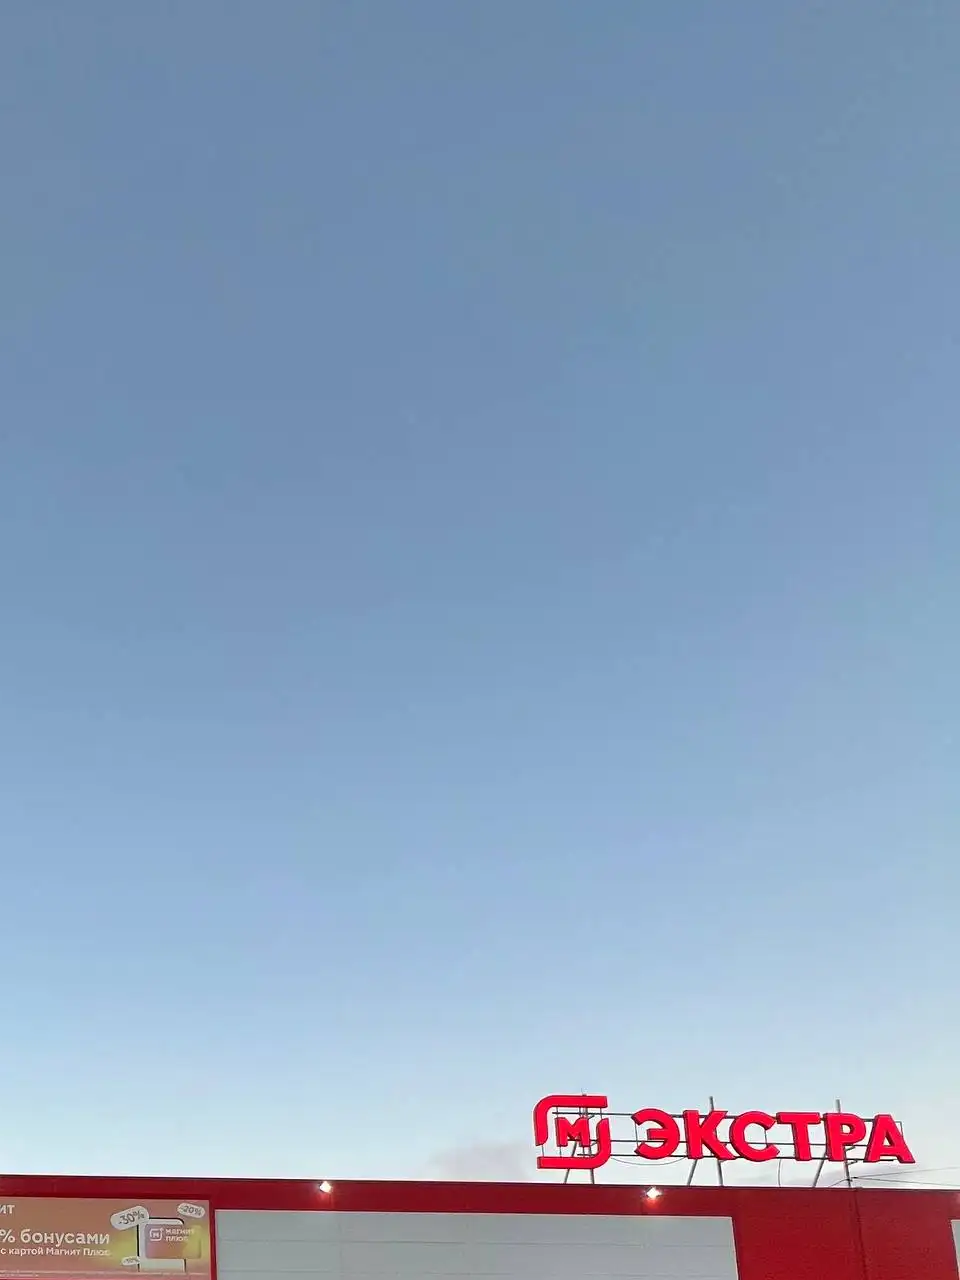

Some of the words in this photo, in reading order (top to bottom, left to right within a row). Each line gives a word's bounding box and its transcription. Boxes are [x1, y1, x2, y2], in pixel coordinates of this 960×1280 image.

[632, 1107, 915, 1164] ЭКСТРА
[119, 1210, 145, 1225] -30%
[181, 1205, 202, 1216] -20%
[20, 1228, 110, 1247] бонусами
[8, 1246, 44, 1257] картой
[45, 1247, 81, 1256] Магнит
